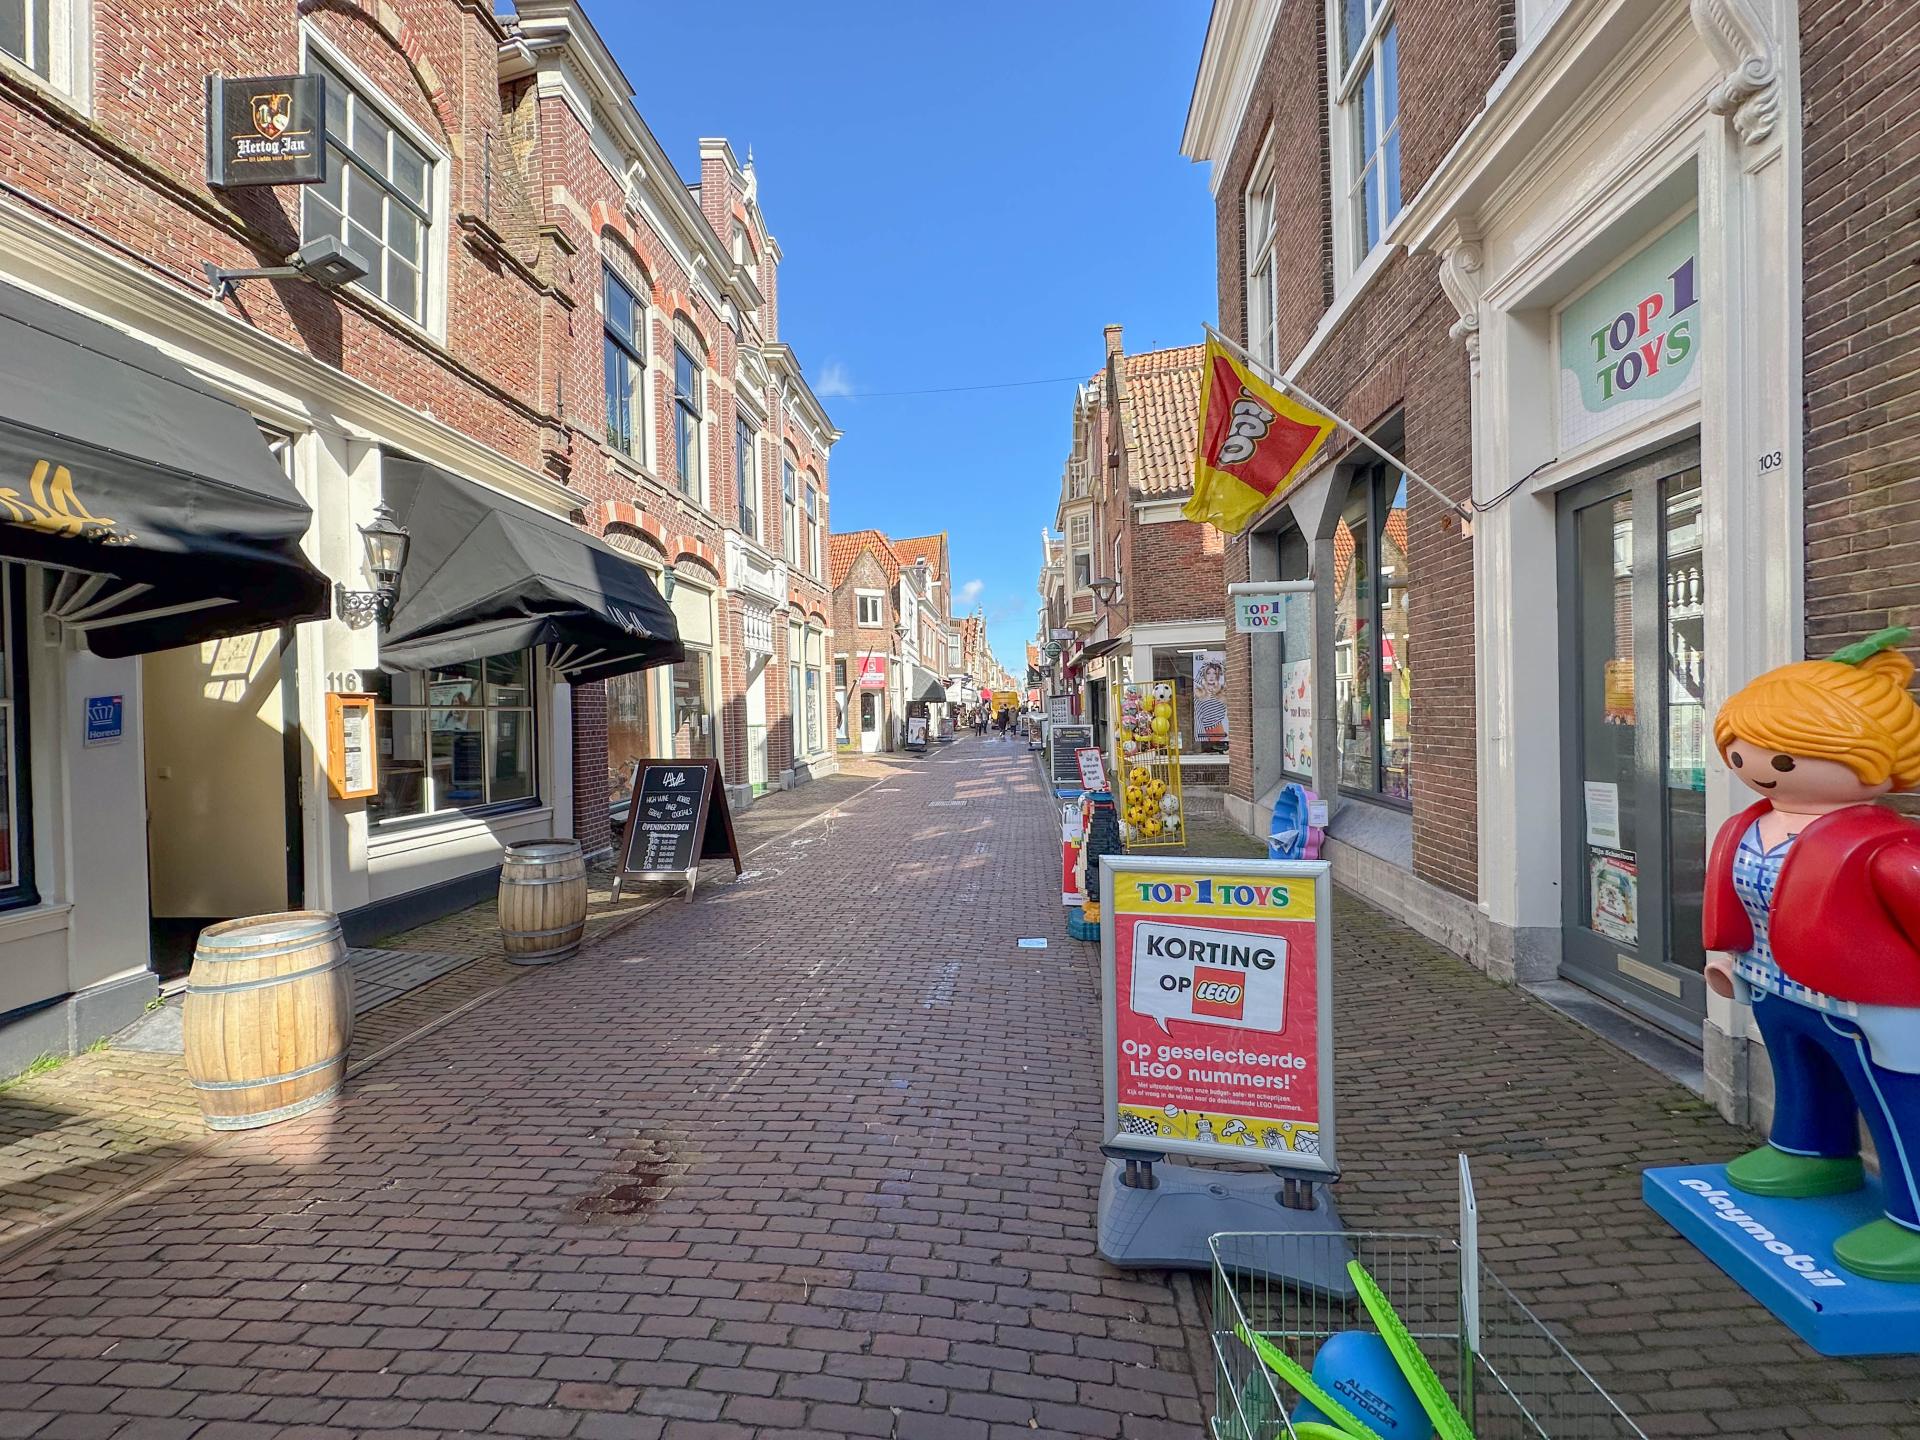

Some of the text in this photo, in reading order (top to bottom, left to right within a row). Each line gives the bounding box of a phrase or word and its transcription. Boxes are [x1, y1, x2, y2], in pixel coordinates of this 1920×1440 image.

[237, 137, 305, 158] Hertog Jan
[1591, 256, 1698, 363] TOP 1
[1597, 321, 1690, 401] TOYS
[1759, 451, 1781, 470] 103
[1243, 602, 1279, 614] TOP 1
[1245, 616, 1278, 626] TOYS
[327, 671, 356, 692] 116
[90, 729, 120, 739] Horeca
[1137, 880, 1289, 906] TOP 1 TOYS
[1147, 935, 1275, 970] KORTING
[1160, 975, 1241, 1004] OP LEGO
[1122, 1039, 1306, 1070] Op geselecteerde
[1130, 1061, 1182, 1080] LEGO
[1679, 1179, 1846, 1287] playmobil
[1334, 1380, 1397, 1429] OUTDOOR
[1345, 1378, 1396, 1411] ALERT
